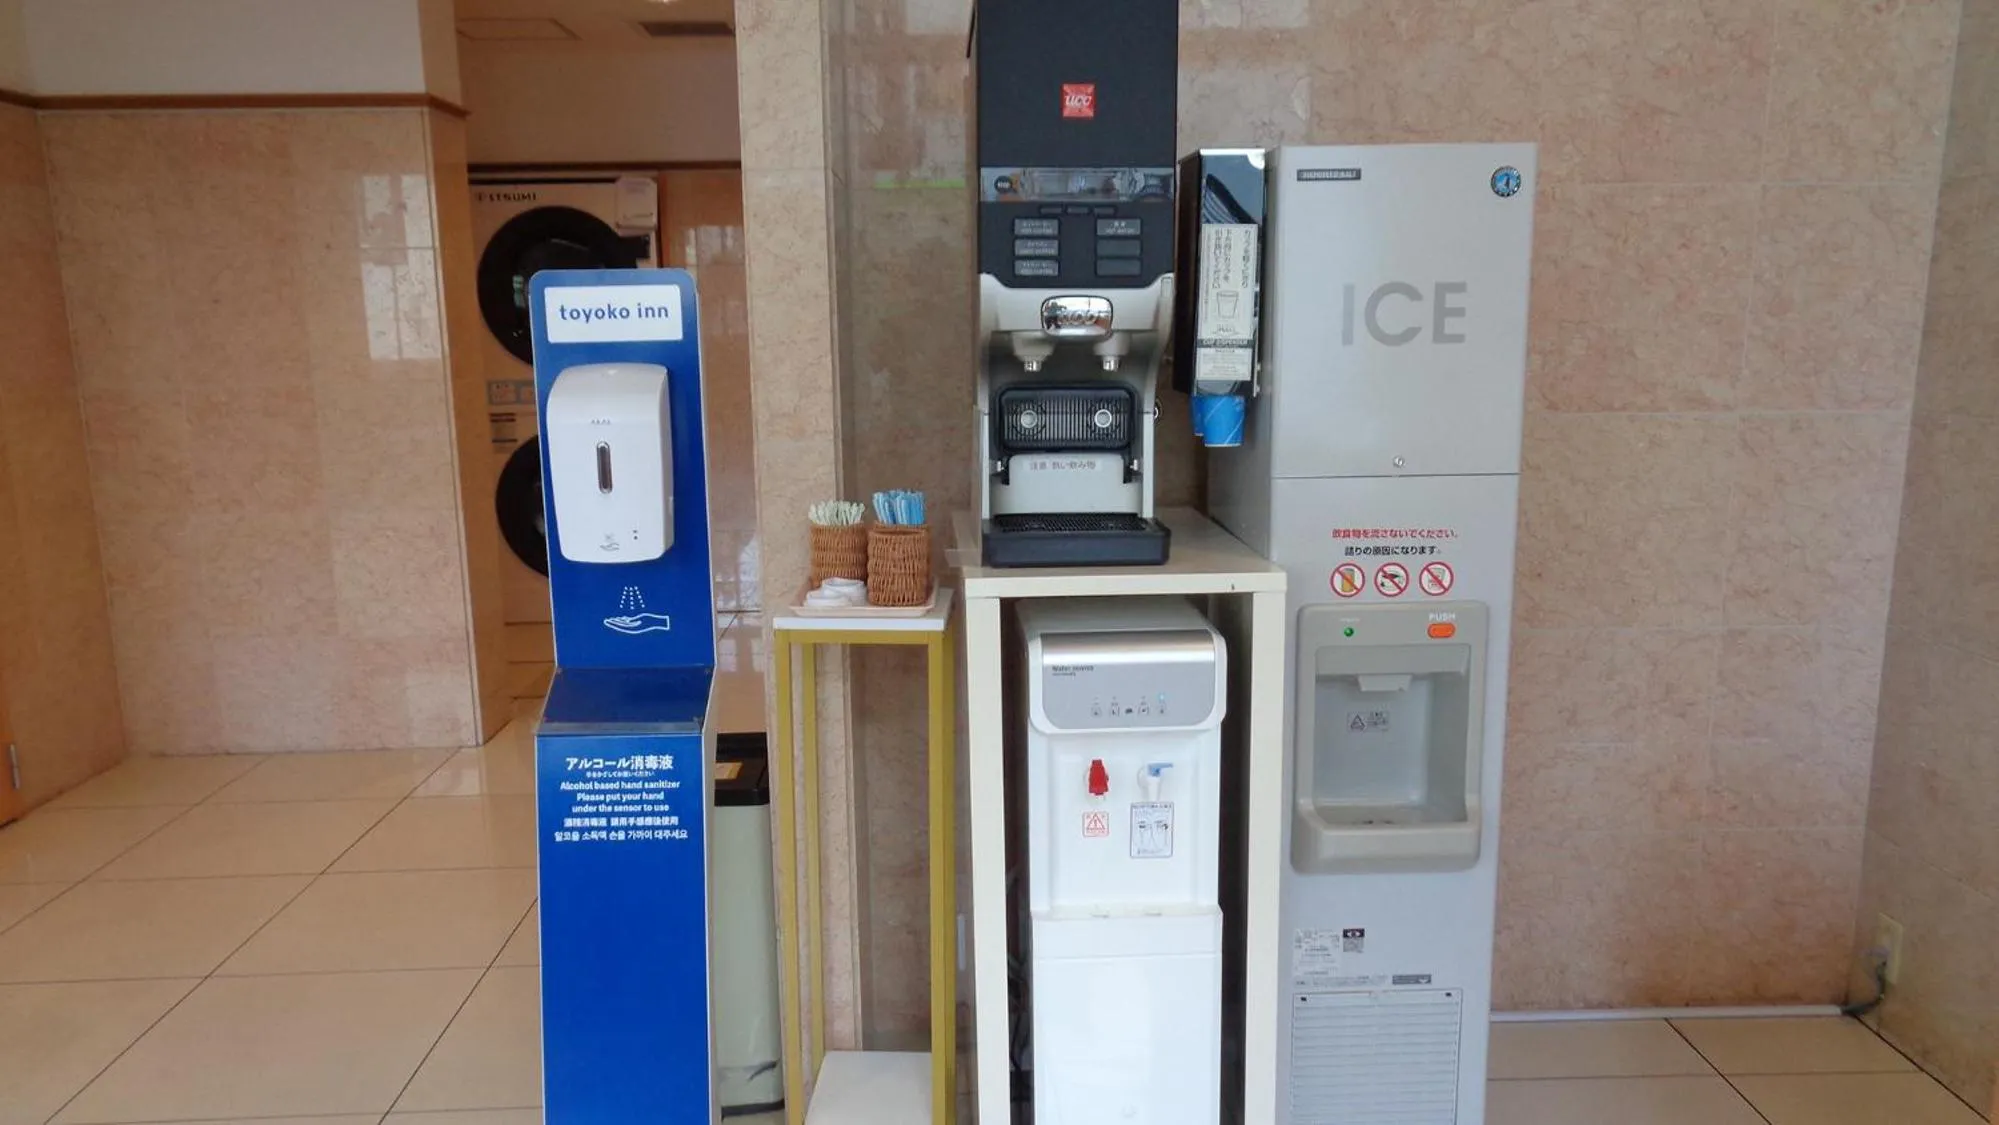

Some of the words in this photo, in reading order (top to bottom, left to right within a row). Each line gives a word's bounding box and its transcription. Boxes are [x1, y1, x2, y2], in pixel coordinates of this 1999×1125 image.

[560, 303, 630, 324] toyoko
[637, 302, 669, 319] inn
[1341, 281, 1468, 347] ICE
[1428, 612, 1456, 622] PUSH
[565, 754, 674, 771] アルコール消毒液
[560, 781, 594, 791] Alcohol
[594, 780, 620, 790] based
[621, 780, 643, 790] hand
[644, 779, 680, 789] sanitizer
[576, 792, 605, 801] Please
[605, 793, 621, 803] put
[621, 793, 641, 803] your
[642, 791, 665, 800] hand
[571, 804, 597, 813] under
[598, 804, 612, 812] the
[613, 804, 641, 812] sensor
[643, 803, 653, 811] to
